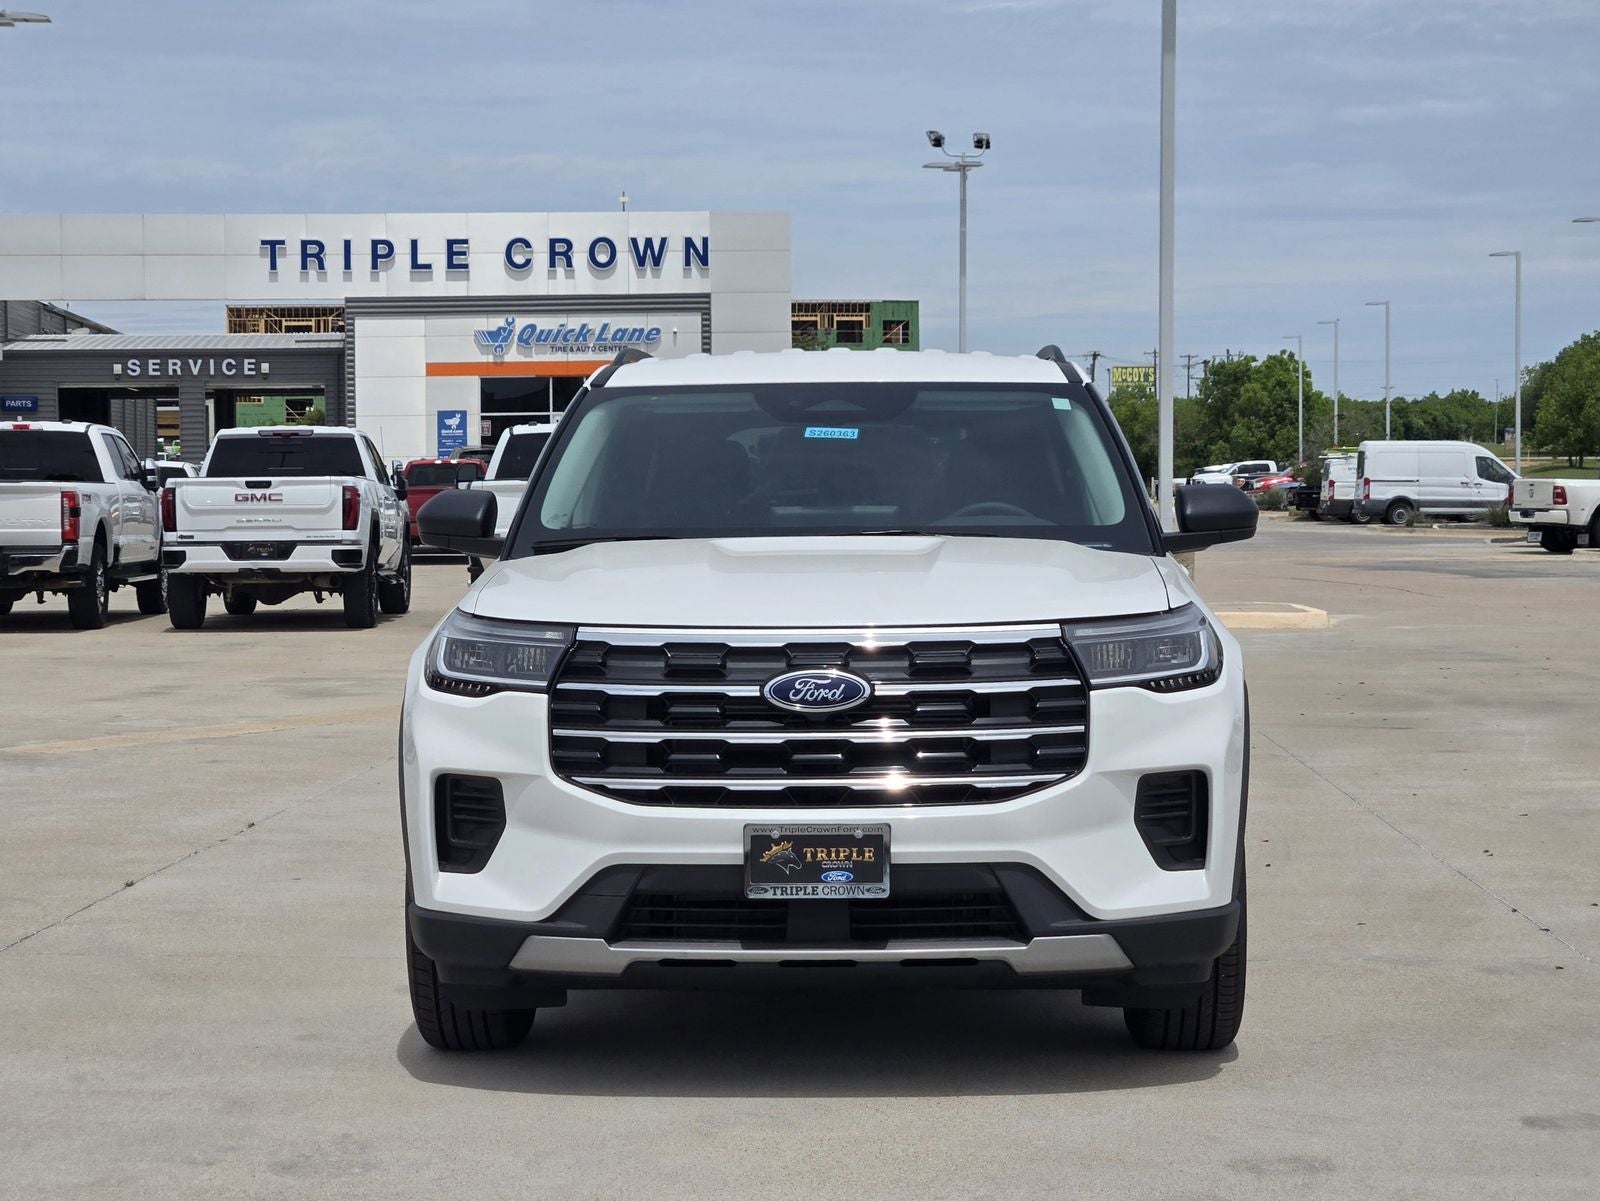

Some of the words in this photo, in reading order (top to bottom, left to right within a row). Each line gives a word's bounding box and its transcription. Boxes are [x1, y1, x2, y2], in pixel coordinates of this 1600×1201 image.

[260, 238, 470, 272] TRIPLE
[504, 236, 710, 271] CROWN
[517, 323, 594, 346] Quick
[595, 323, 662, 344] Lane
[550, 345, 569, 353] TIRE
[569, 345, 575, 353] &
[575, 345, 597, 353] AUTO
[126, 358, 257, 376] SERVICE
[5, 400, 32, 408] PARTS
[808, 428, 856, 438] S260363
[234, 493, 283, 502] GMC
[788, 678, 846, 702] Ford
[751, 824, 884, 834] wwwTripleCrownFordcom
[803, 847, 876, 862] TRIPLE
[821, 860, 854, 868] CROWN
[827, 871, 848, 881] Ford
[770, 885, 819, 896] TRIPLE
[821, 885, 865, 896] CROWN
